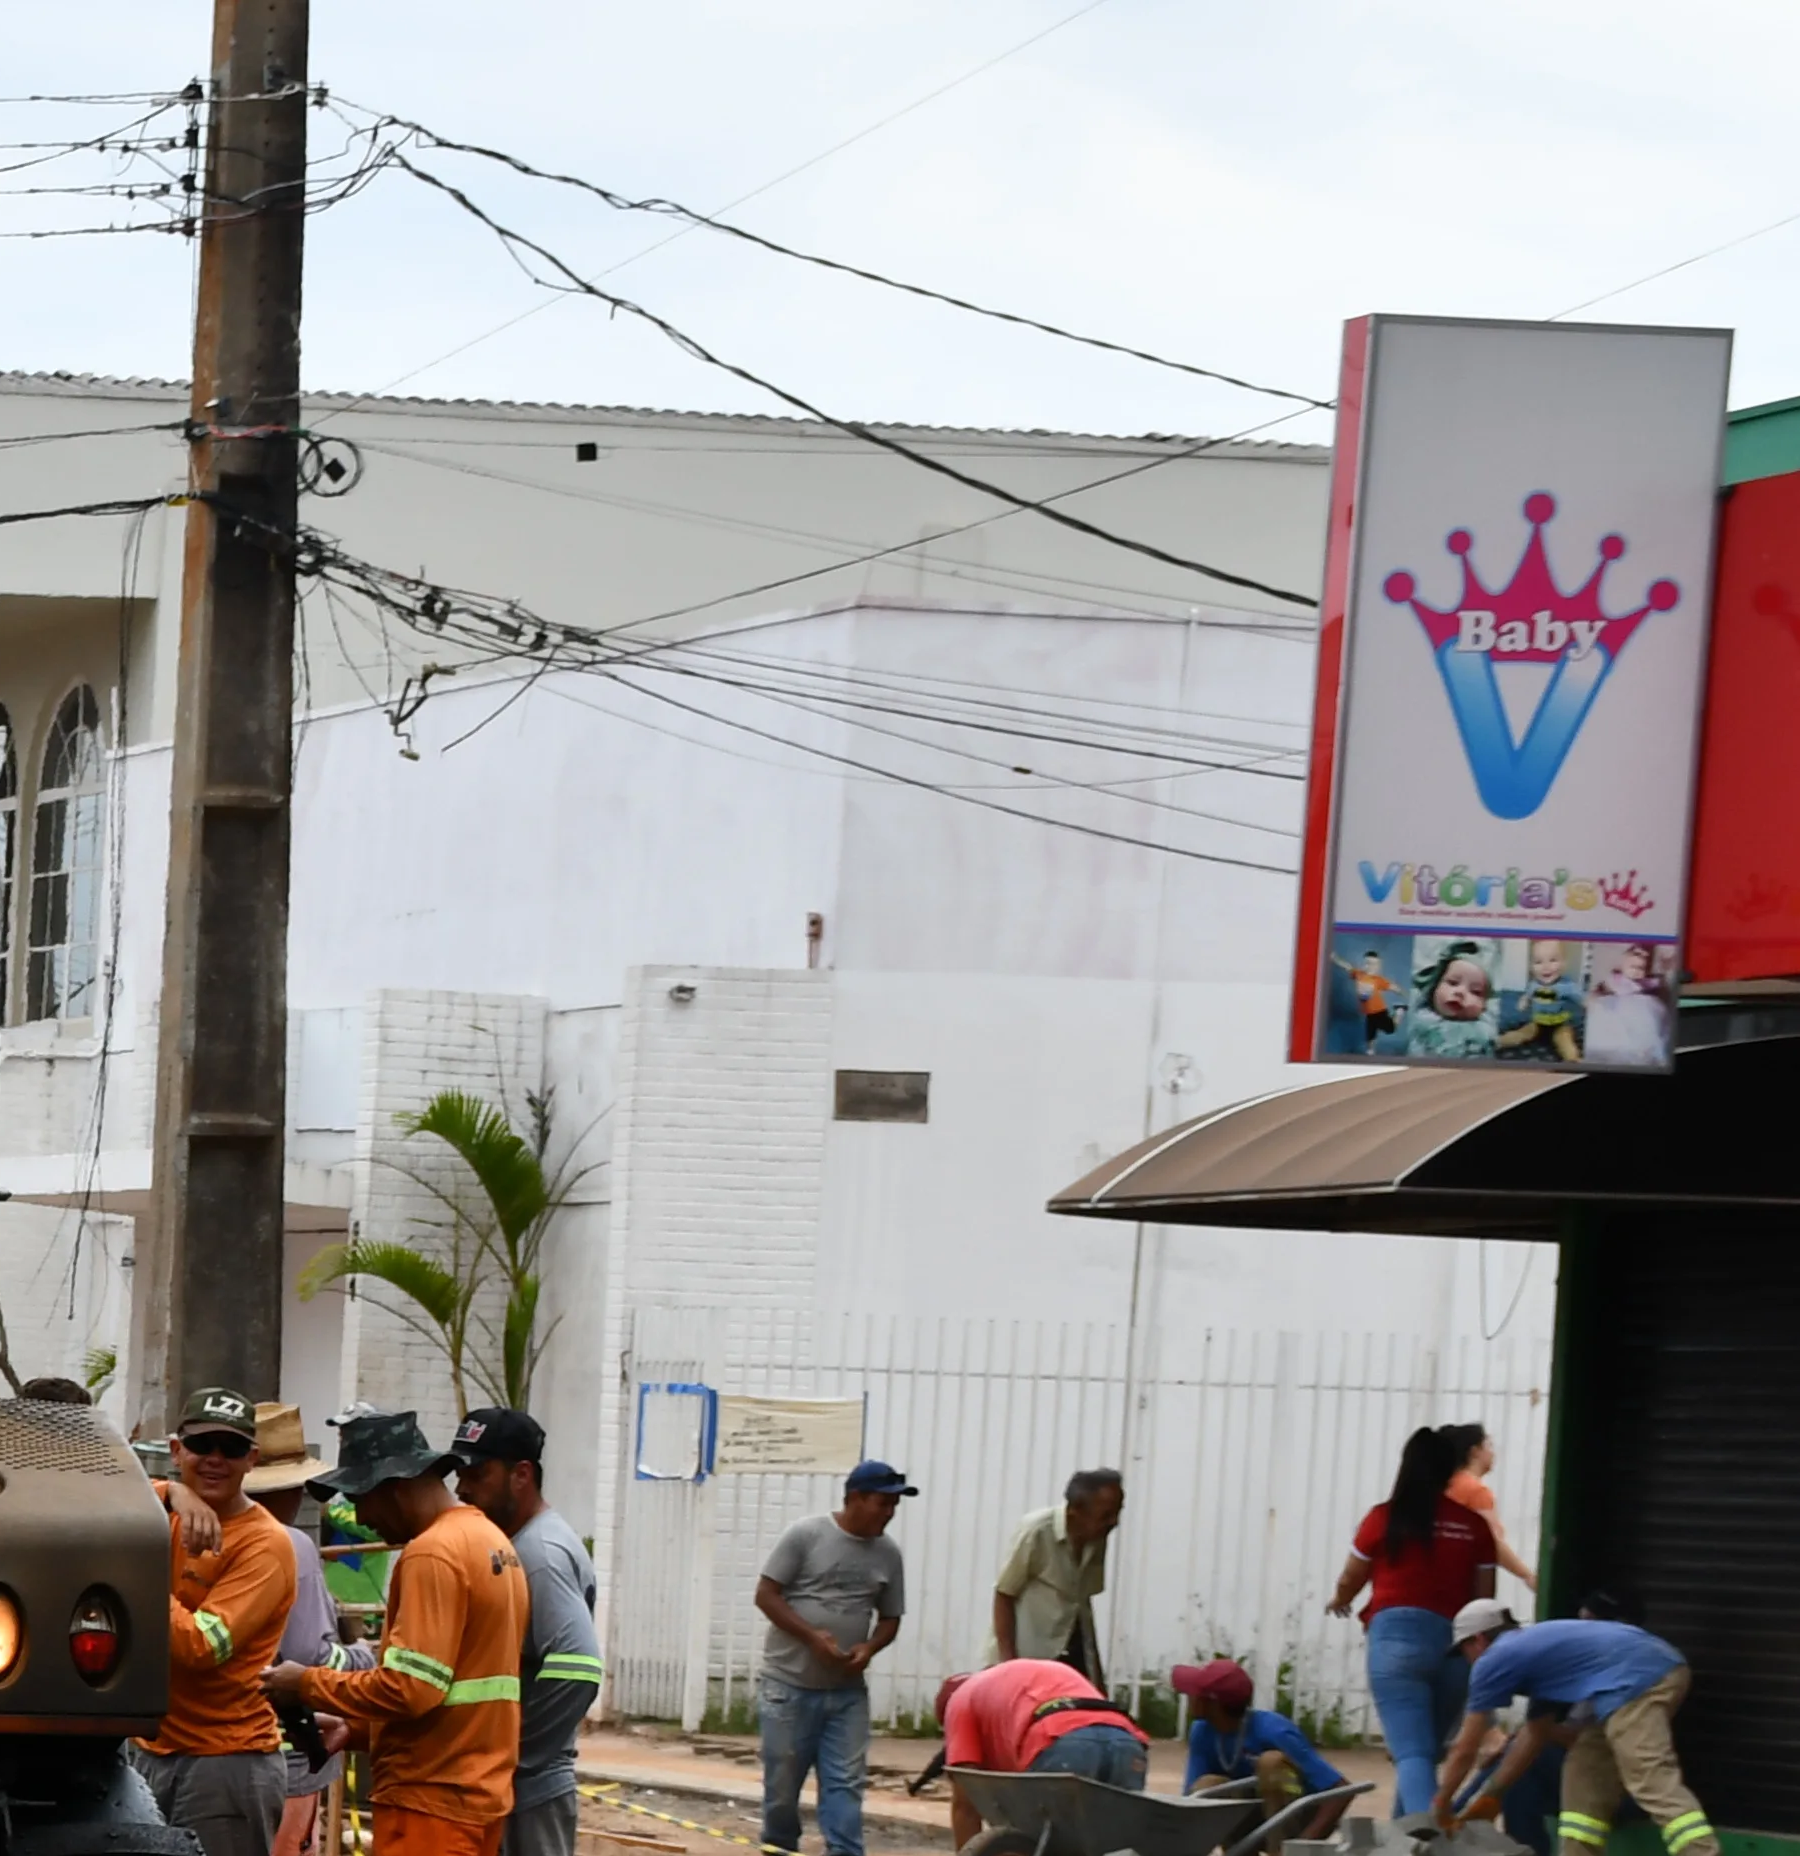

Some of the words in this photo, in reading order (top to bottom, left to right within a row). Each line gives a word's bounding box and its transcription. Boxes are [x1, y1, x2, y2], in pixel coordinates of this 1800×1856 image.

[1456, 609, 1607, 661] Baby
[1435, 635, 1614, 820] V
[1357, 860, 1598, 911] Vitória's
